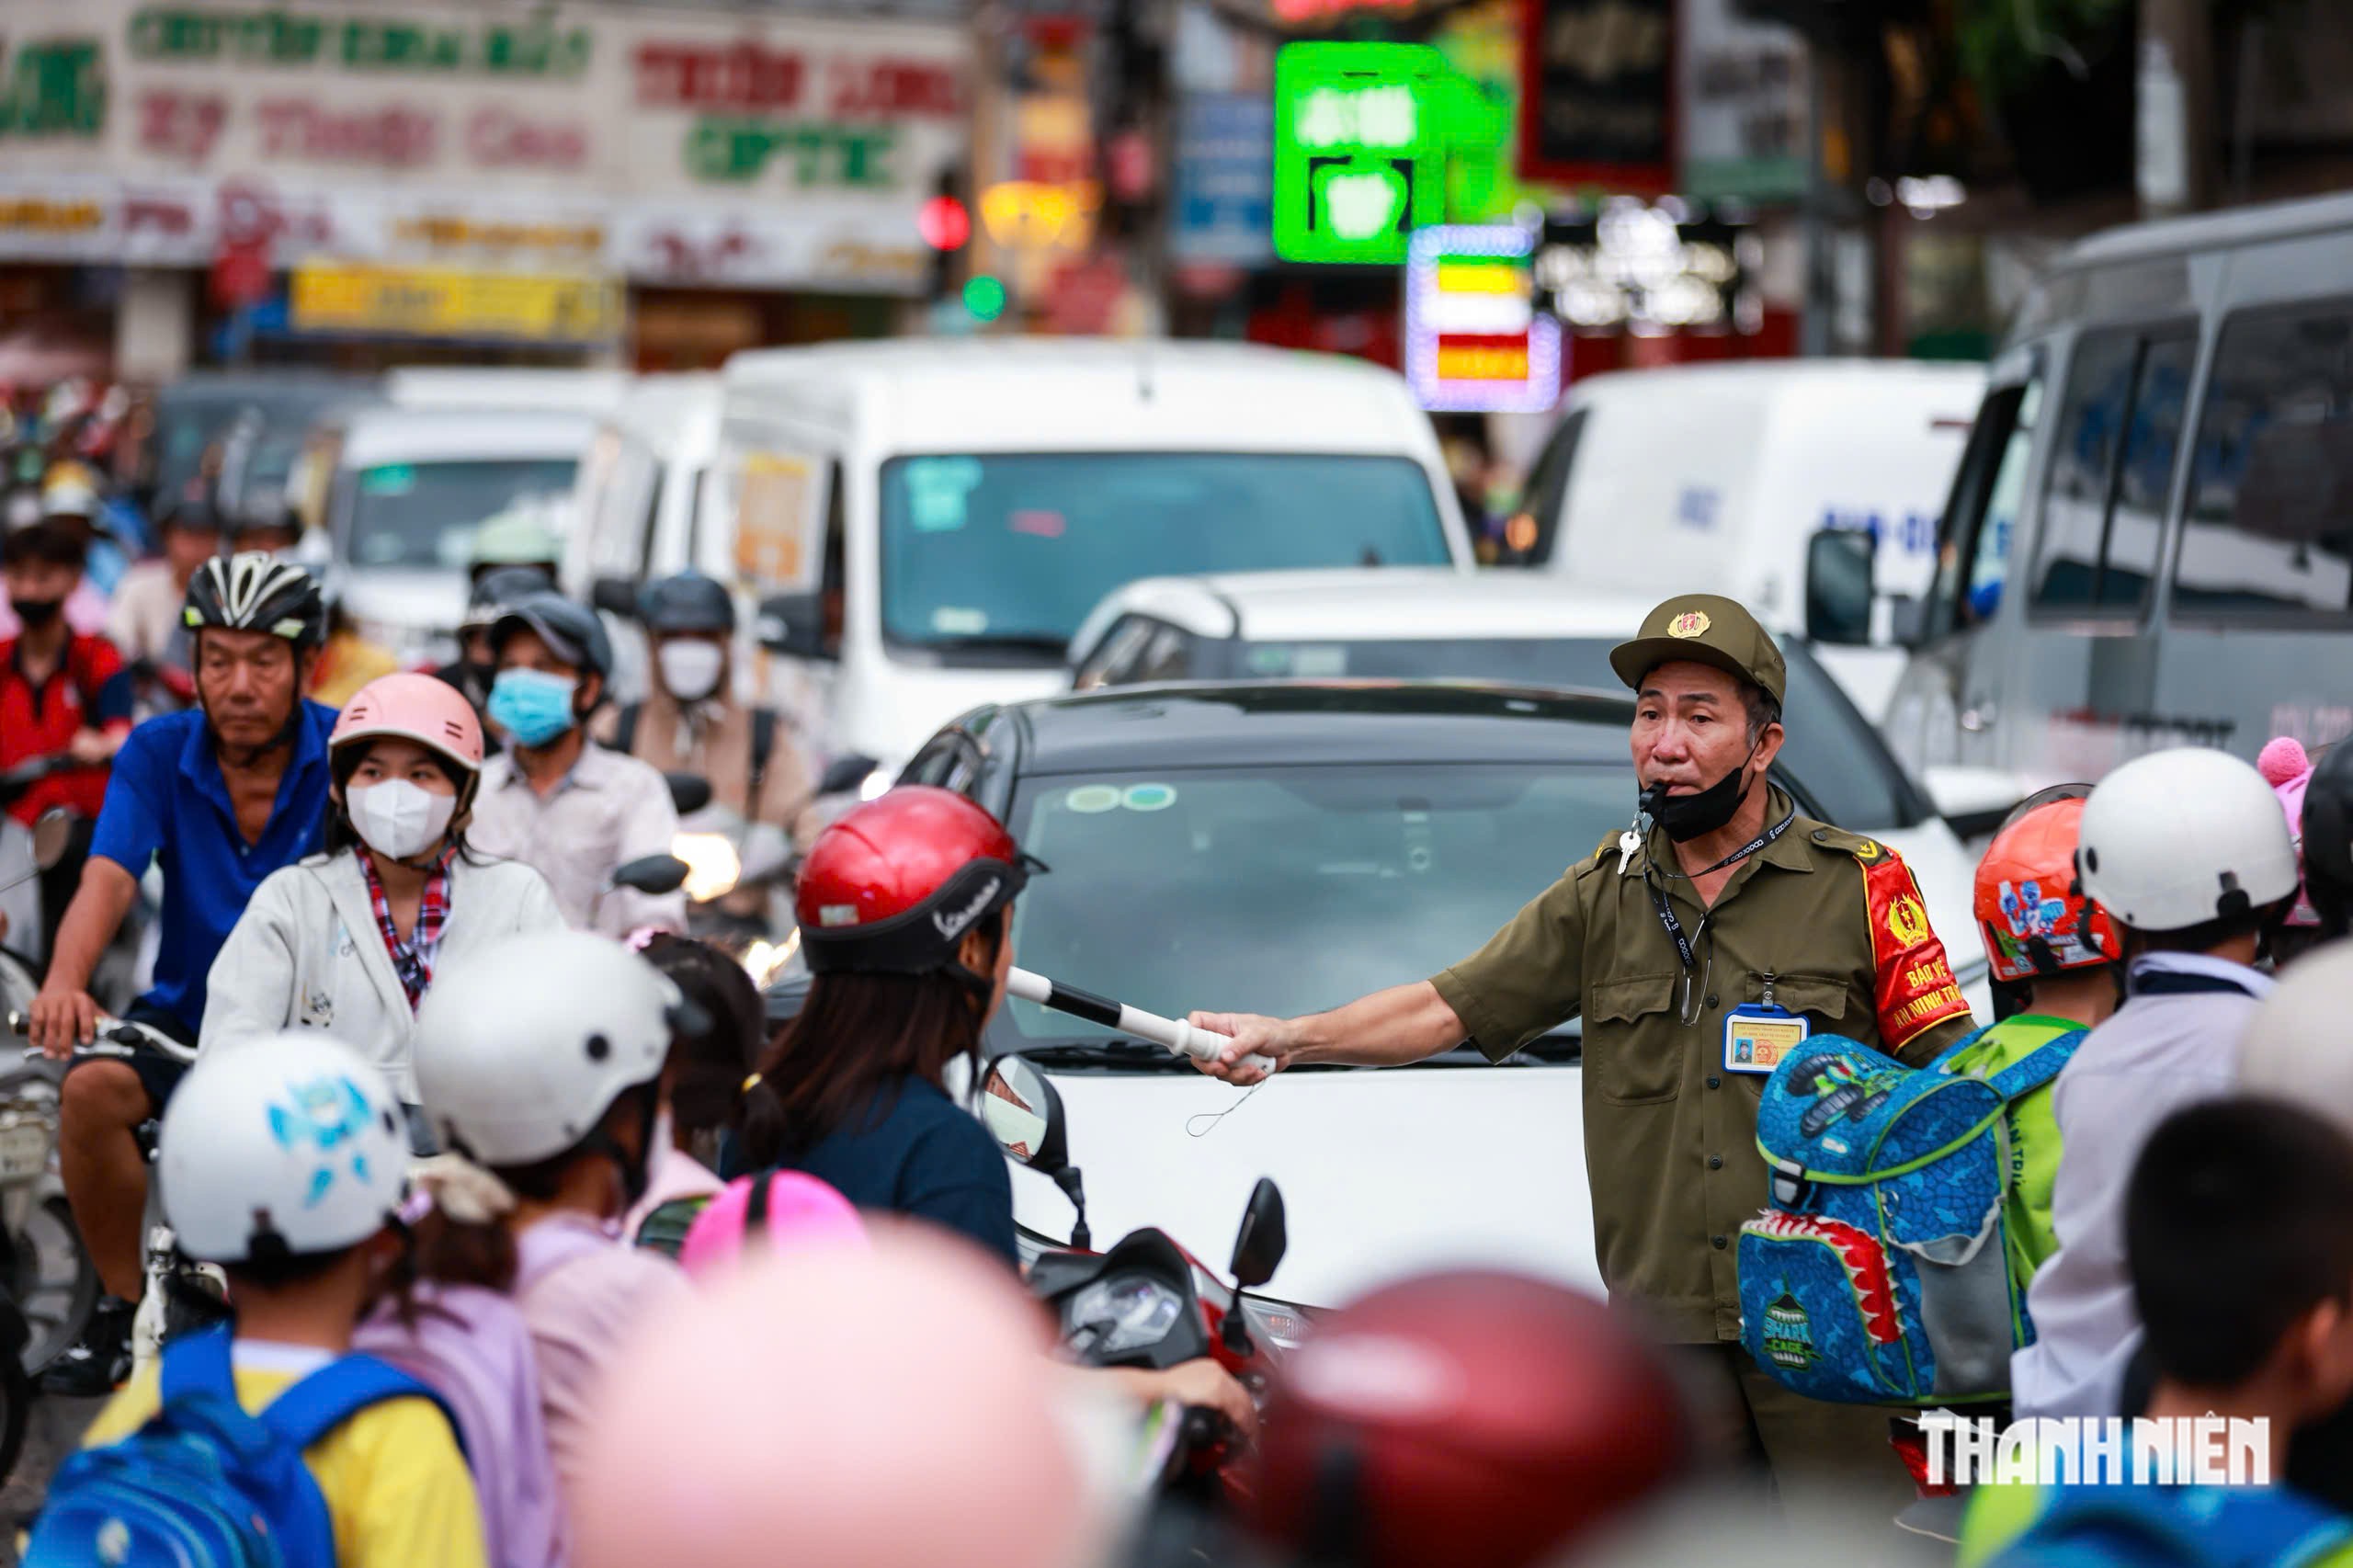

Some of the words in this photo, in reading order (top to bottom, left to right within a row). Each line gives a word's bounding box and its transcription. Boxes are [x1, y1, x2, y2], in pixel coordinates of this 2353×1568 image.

[1906, 961, 1934, 988] BẢO
[1894, 1007, 1912, 1028] AN
[1908, 991, 1944, 1017] NINH
[1765, 1316, 1813, 1345] SHARK
[1772, 1339, 1803, 1356] CAGE
